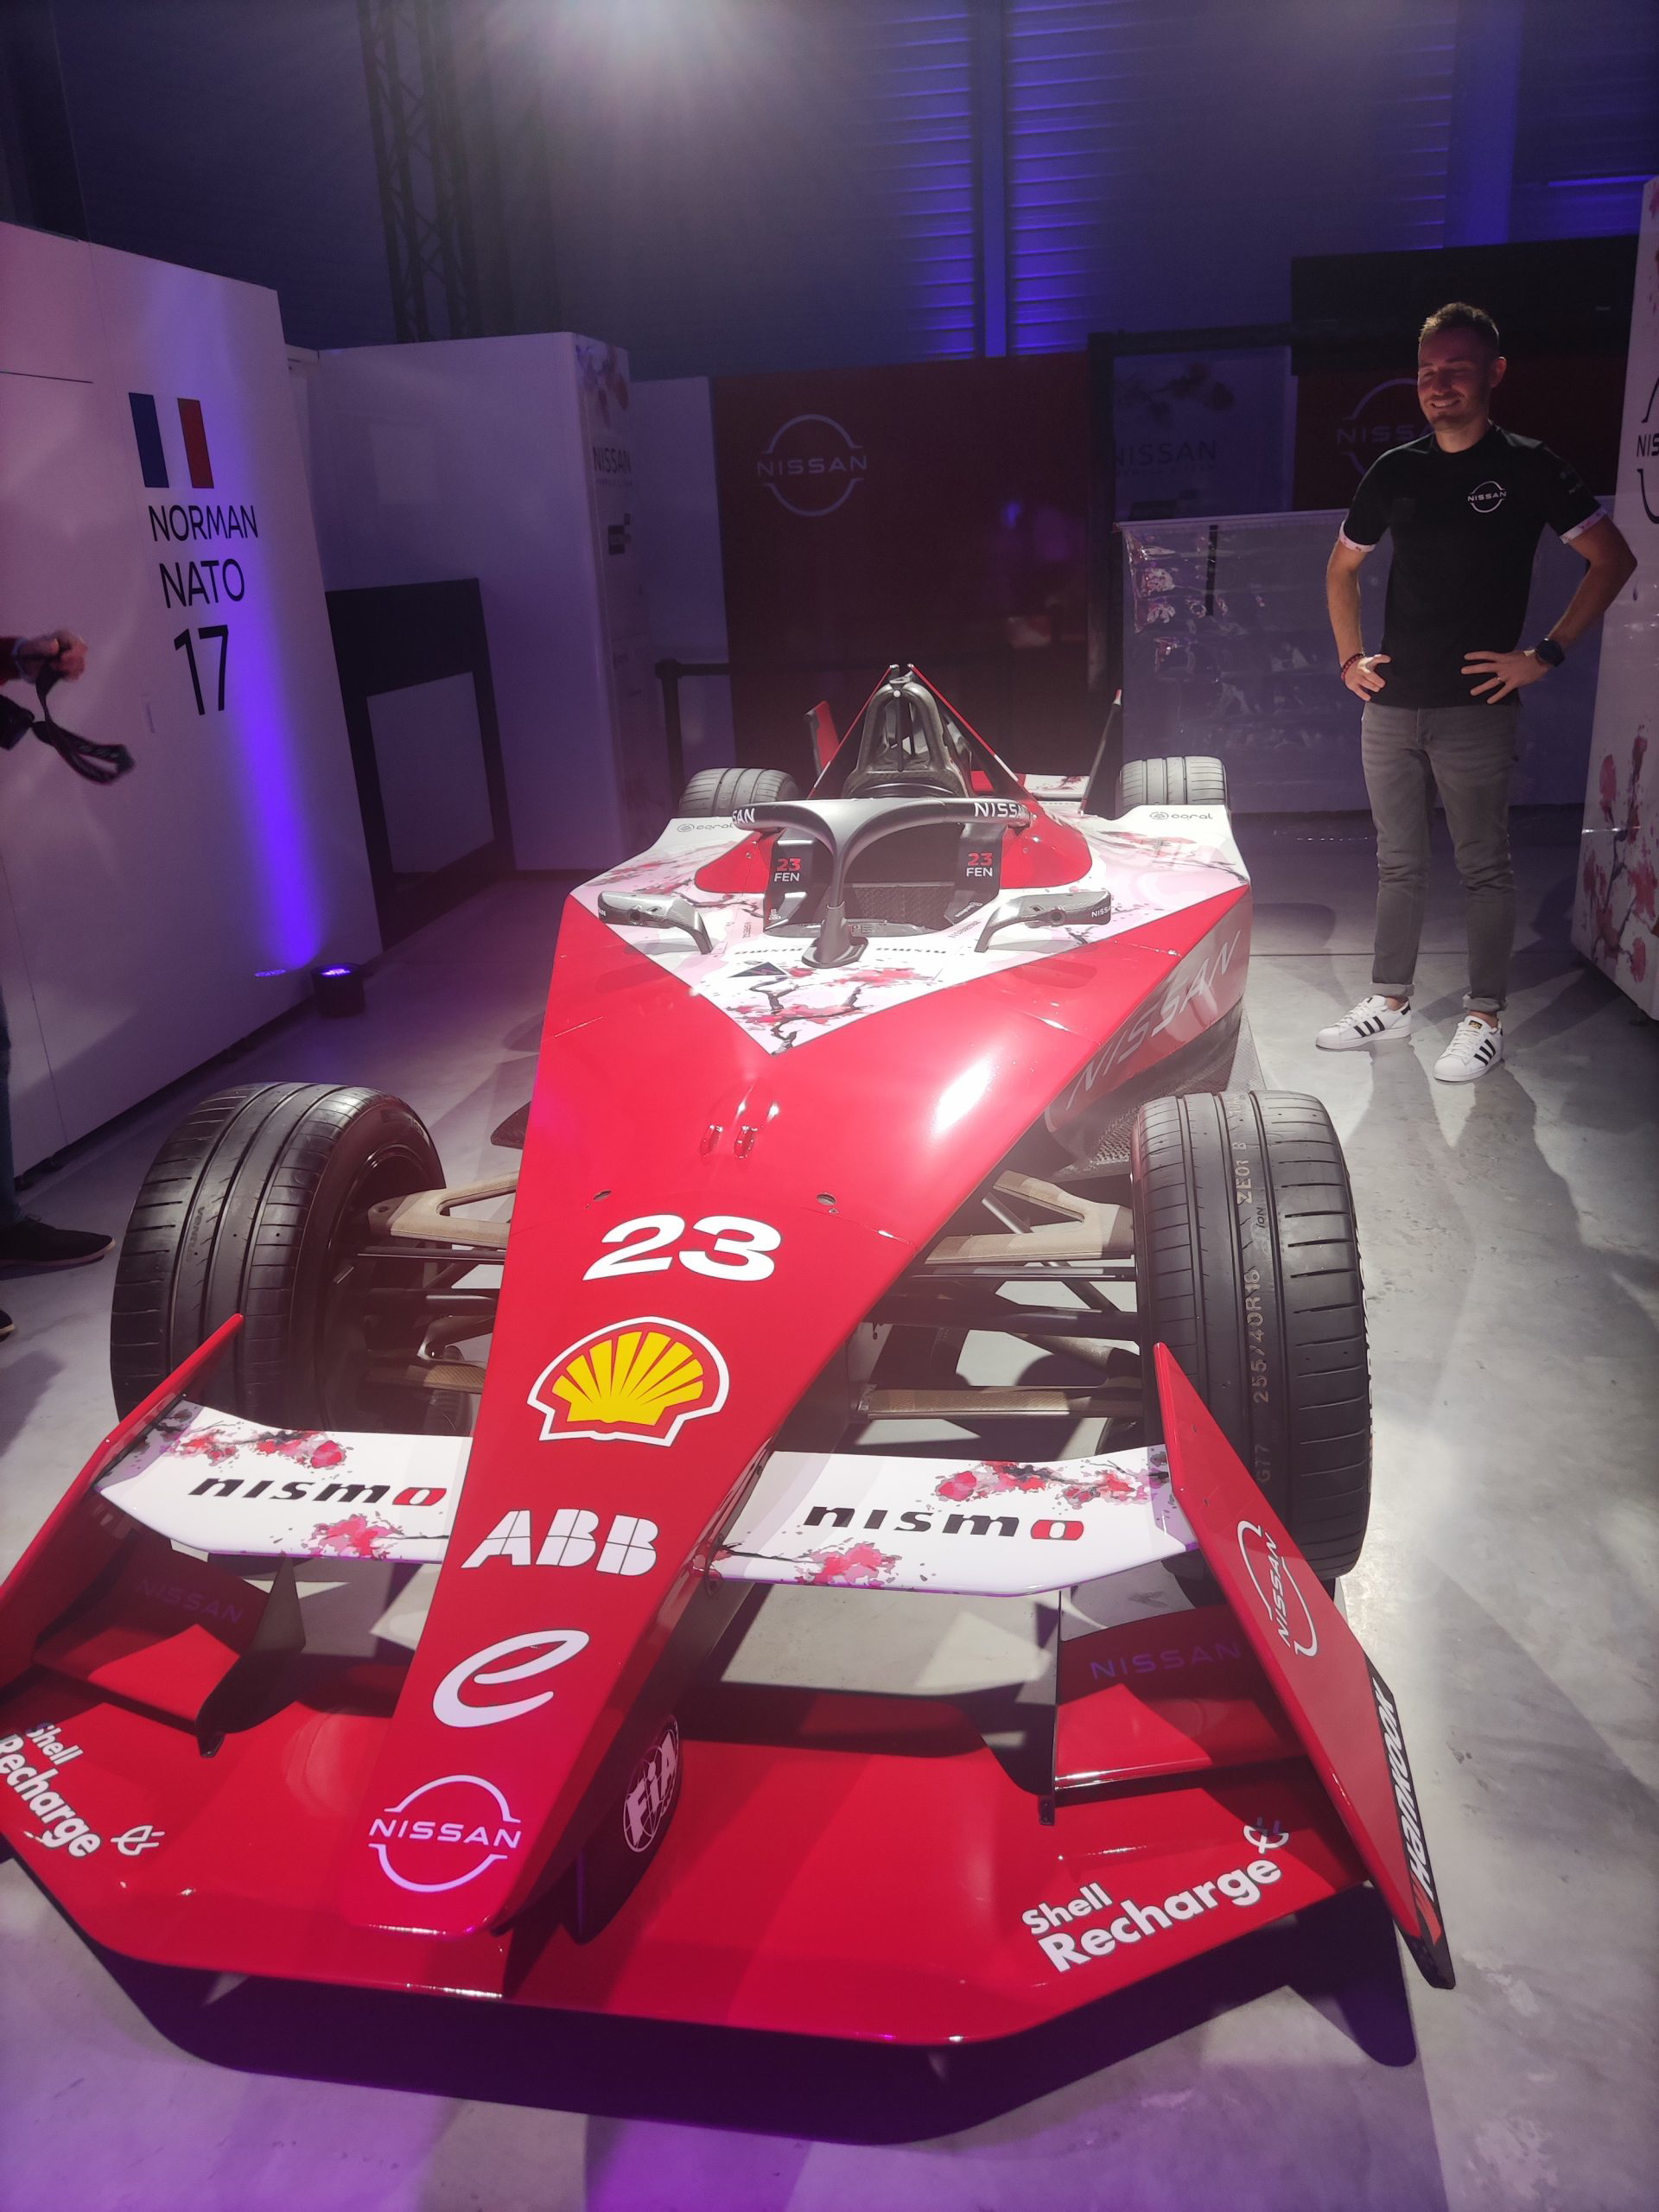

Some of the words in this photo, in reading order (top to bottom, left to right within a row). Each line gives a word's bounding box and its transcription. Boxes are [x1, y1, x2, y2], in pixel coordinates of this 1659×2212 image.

[593, 446, 632, 474] NISSAN
[756, 454, 868, 477] NISSAN
[1467, 490, 1507, 502] NISSAN
[149, 505, 258, 542] NORMAN
[159, 558, 245, 609] NATO
[173, 624, 229, 715] 17
[732, 808, 755, 824] SAN
[774, 872, 800, 882] FEN
[776, 858, 802, 872] 23
[966, 866, 994, 878] FEN
[967, 852, 993, 866] 23
[1065, 928, 1243, 1112] NISSAN
[582, 1213, 782, 1281] 23
[188, 1475, 447, 1506] nismo
[461, 1508, 658, 1576] ABB
[804, 1505, 1084, 1541] nismo
[135, 1579, 246, 1624] NISSAN
[1264, 1533, 1293, 1649] NISSAN
[1090, 1642, 1242, 1681] NISSAN
[26, 1722, 84, 1765] Shell
[0, 1733, 102, 1858] Recharge
[369, 1817, 522, 1849] NISSAN
[1022, 1883, 1113, 1935] Shell
[1038, 1859, 1281, 1973] Recharge
